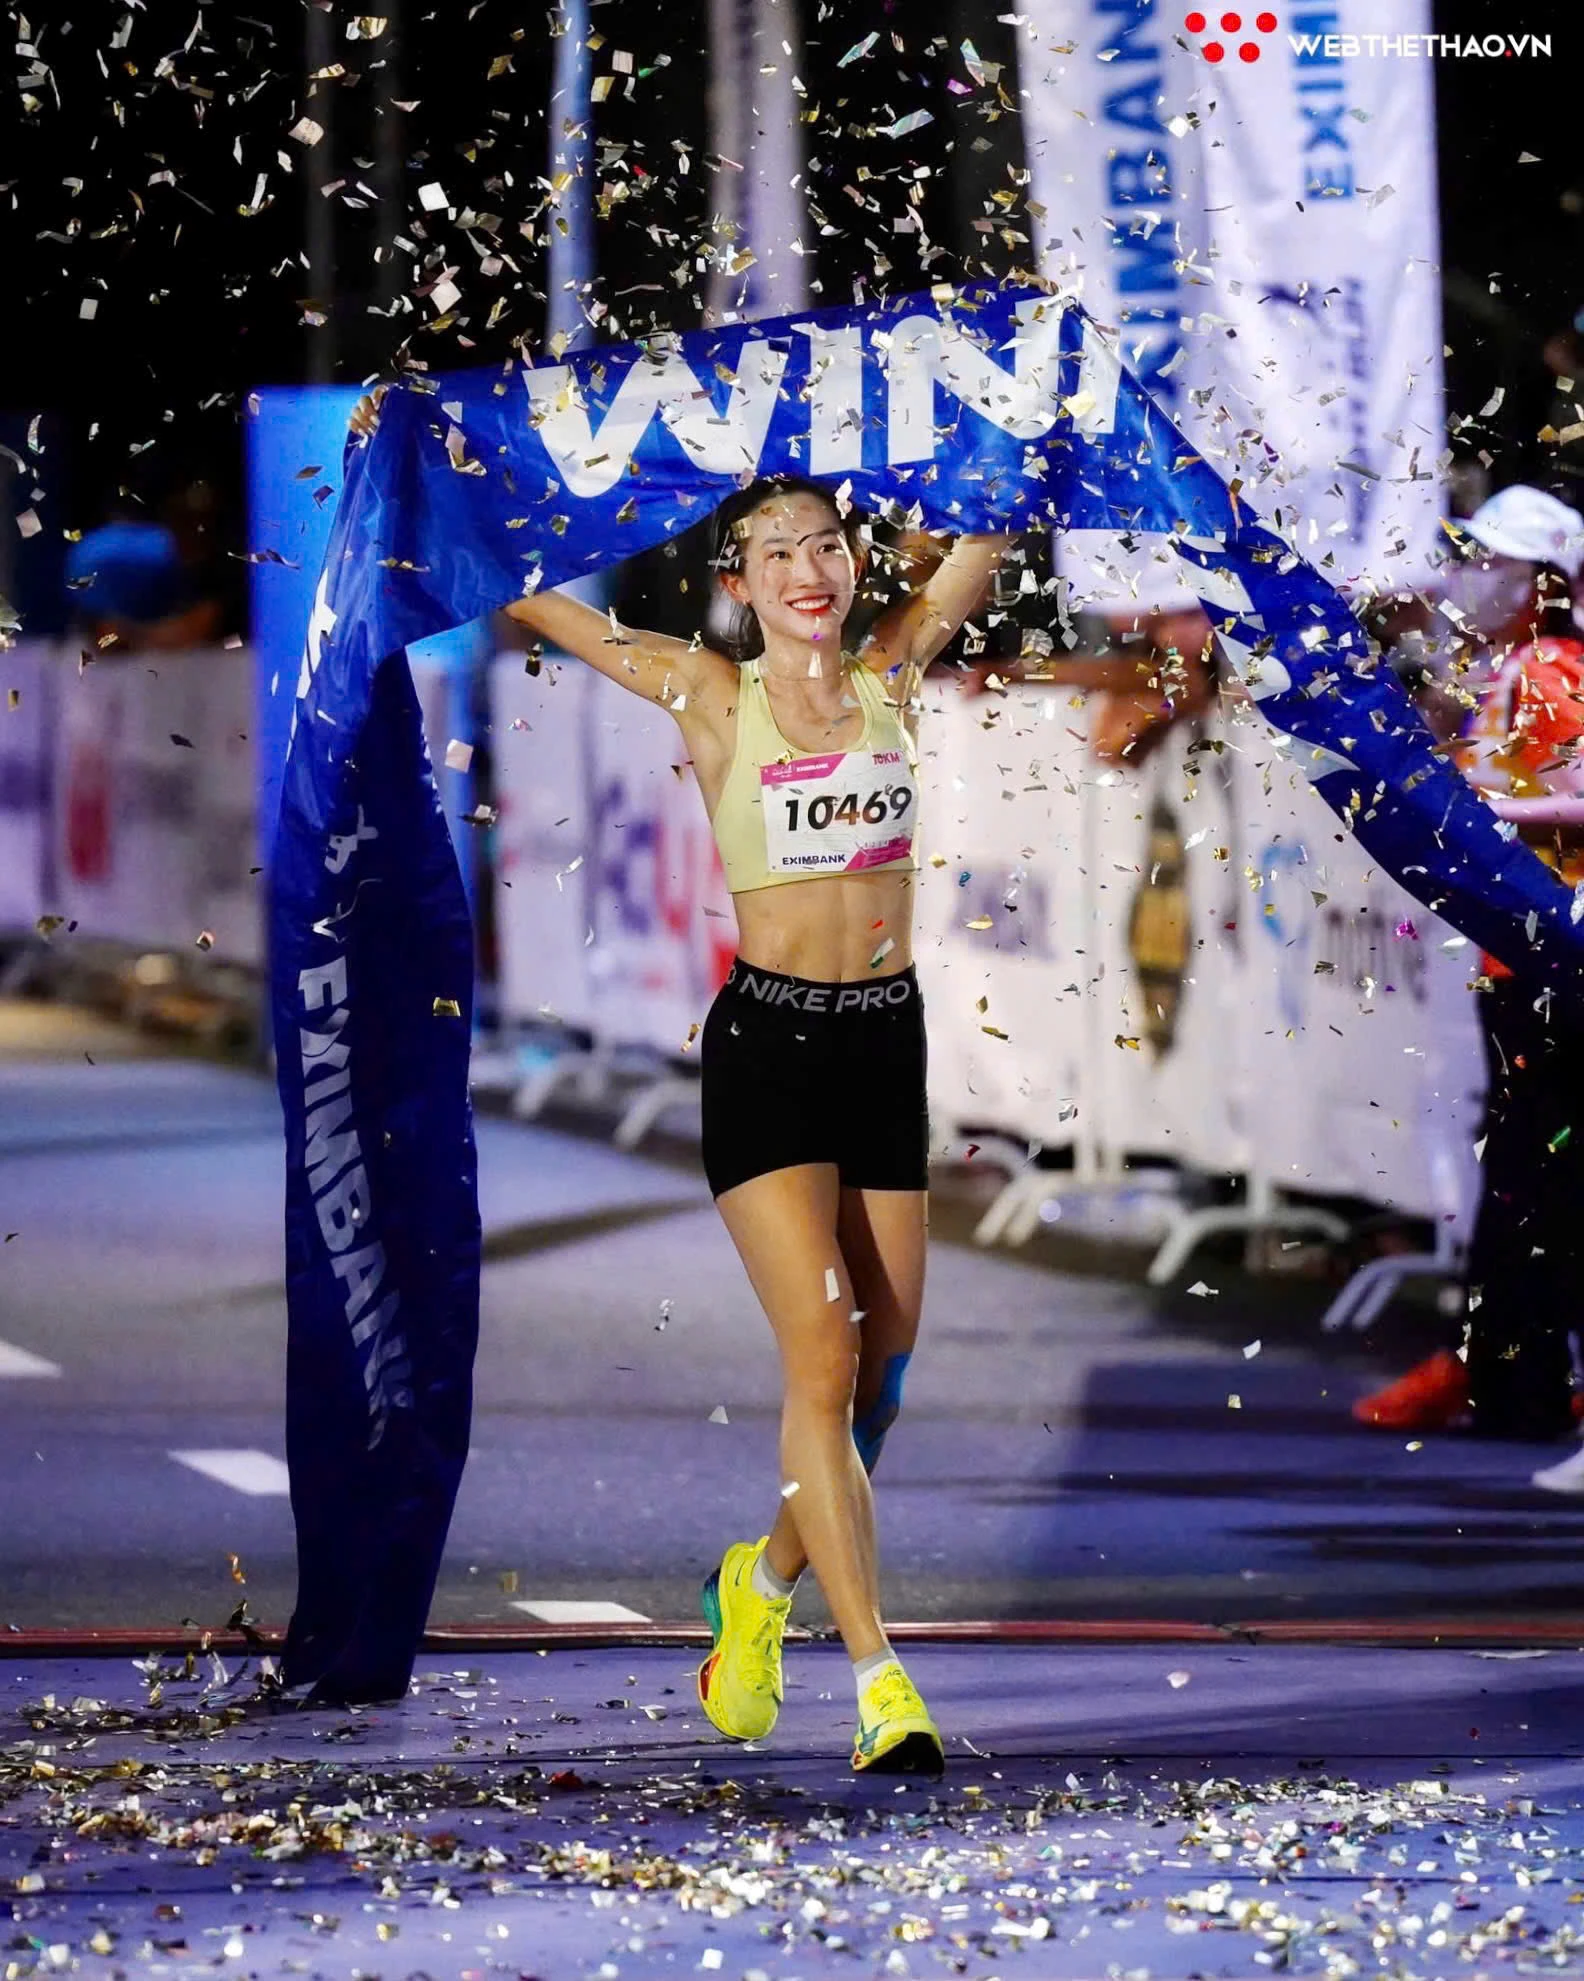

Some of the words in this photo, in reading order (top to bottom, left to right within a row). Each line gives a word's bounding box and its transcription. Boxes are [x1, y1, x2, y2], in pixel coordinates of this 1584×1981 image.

[1292, 0, 1353, 199] EXIM
[1096, 0, 1176, 397] XIMBAN
[872, 752, 901, 766] 10KM
[785, 786, 912, 832] 10469
[782, 854, 846, 866] EXIMBANK
[739, 973, 832, 1012] NIKE
[834, 980, 911, 1014] PRO
